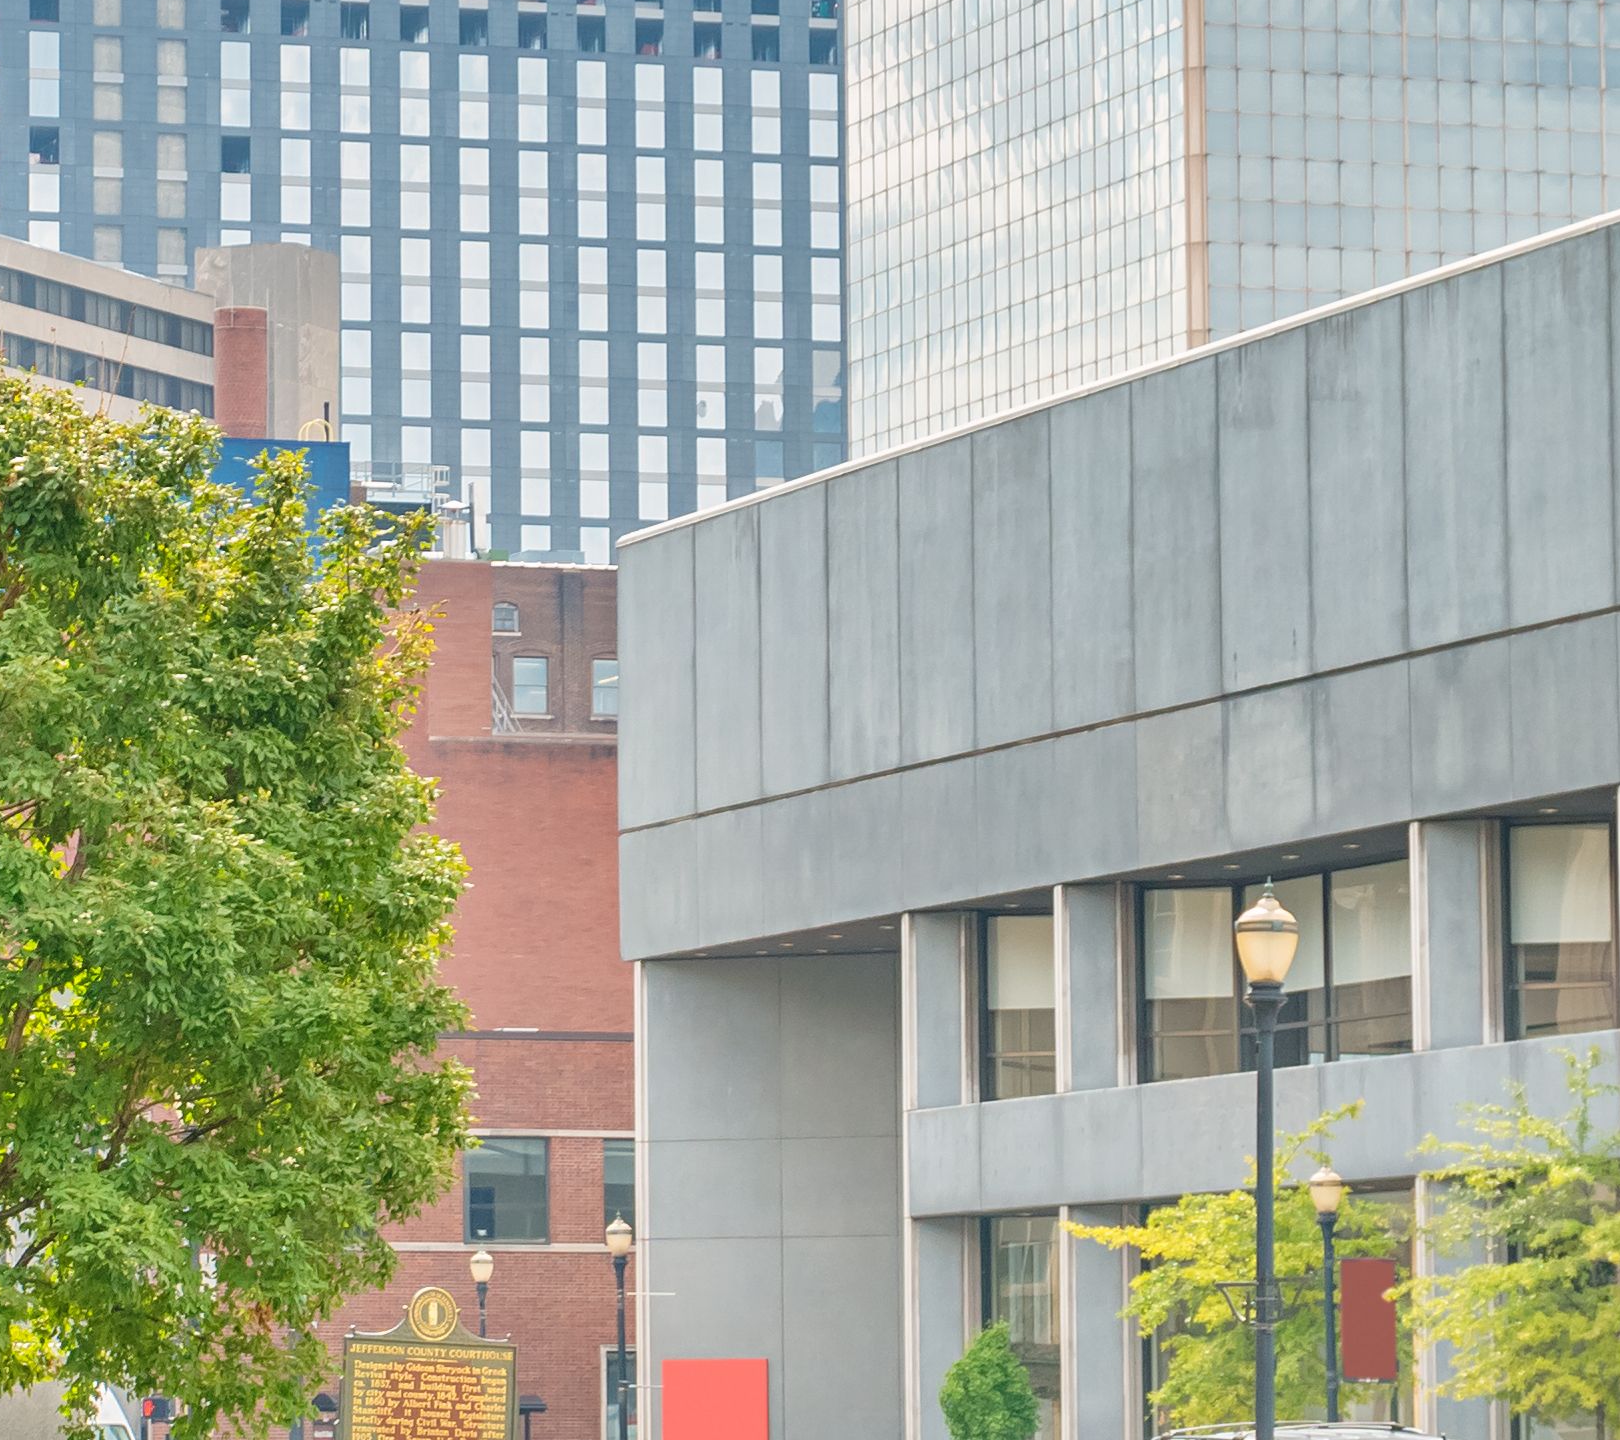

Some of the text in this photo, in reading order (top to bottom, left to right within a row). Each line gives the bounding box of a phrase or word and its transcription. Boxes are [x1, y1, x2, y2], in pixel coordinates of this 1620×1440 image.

[350, 1344, 513, 1360] JEFFERSON COUNTY COURTHOUSE
